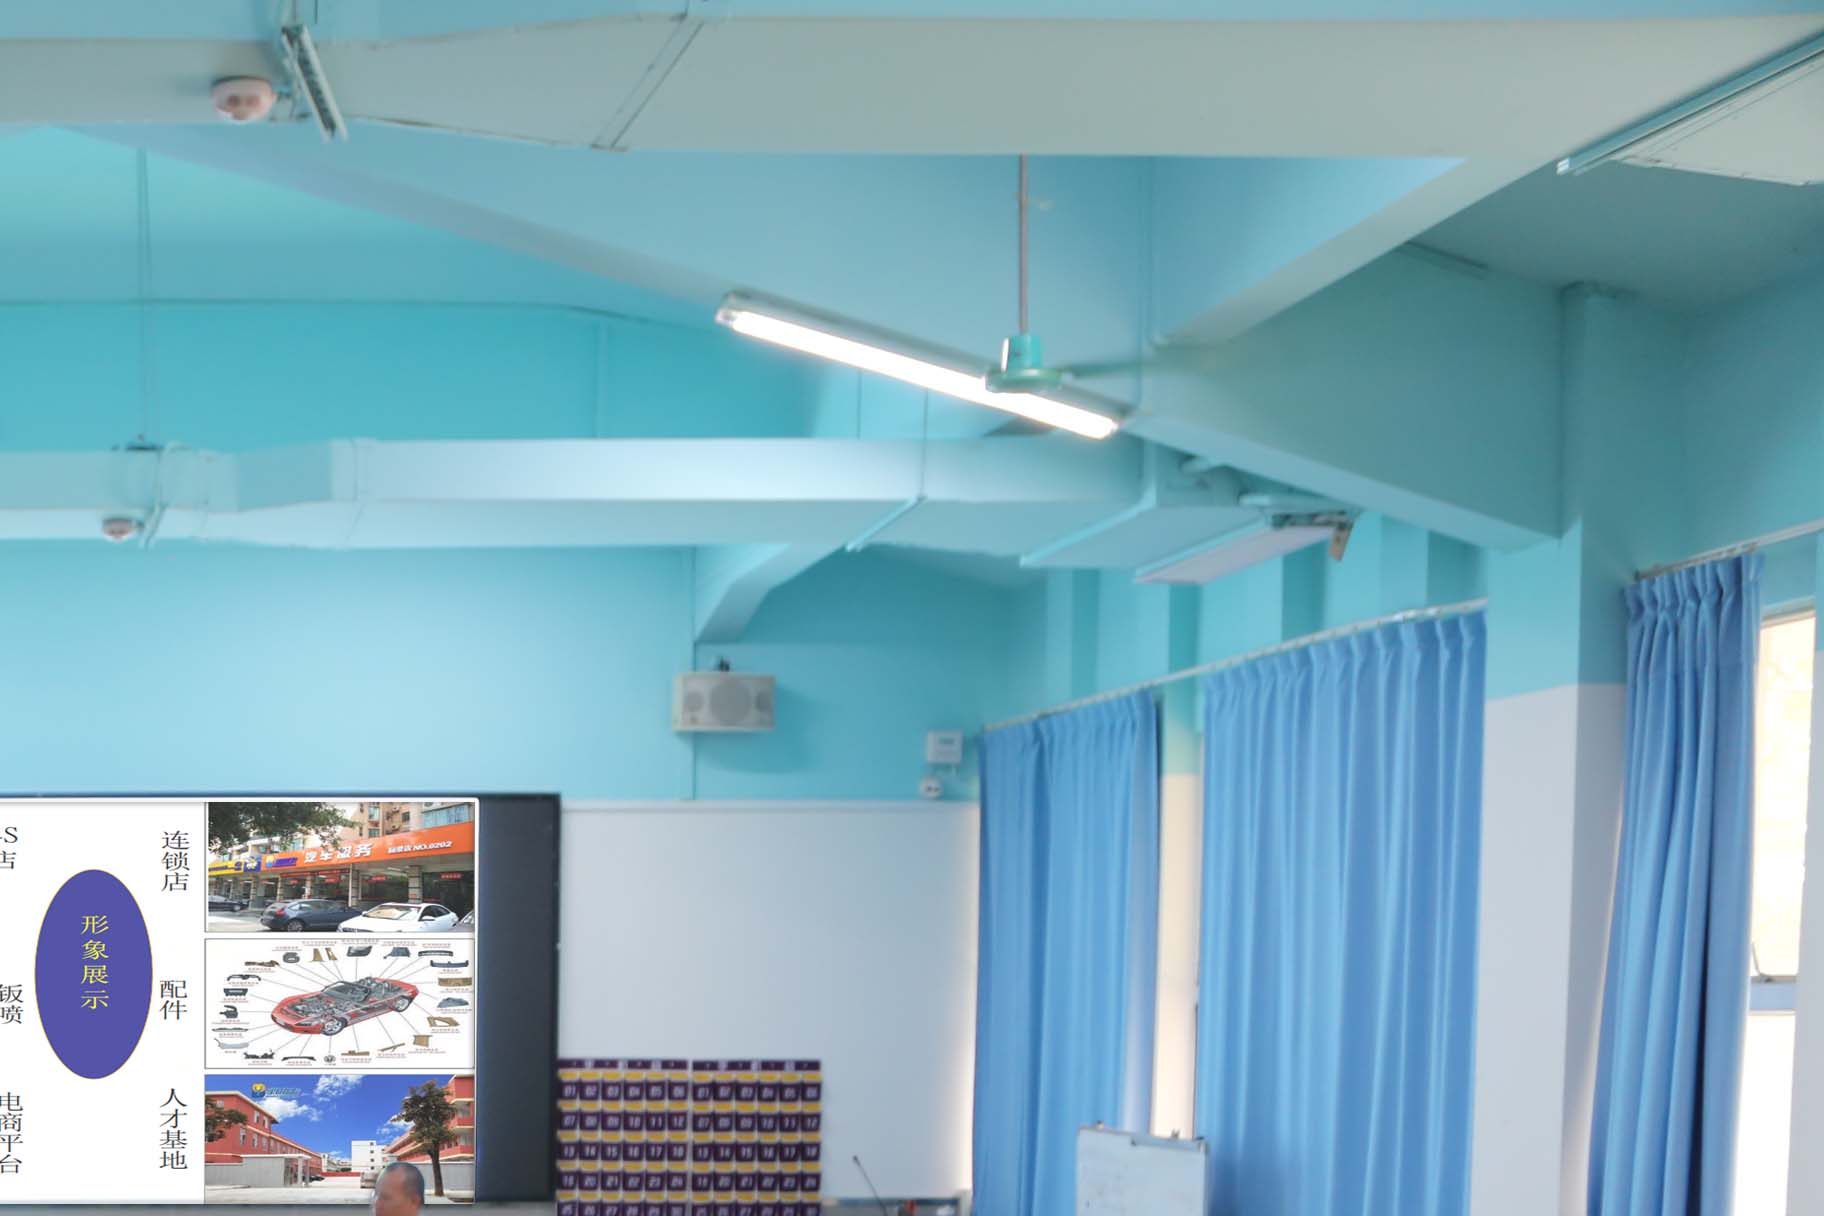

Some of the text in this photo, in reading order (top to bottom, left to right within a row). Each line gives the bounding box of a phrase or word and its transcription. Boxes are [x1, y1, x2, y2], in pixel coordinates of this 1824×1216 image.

[161, 830, 190, 892] 连锁店
[81, 915, 110, 1010] 形象展示
[159, 980, 188, 1020] 配件
[159, 1088, 188, 1170] 人才基地
